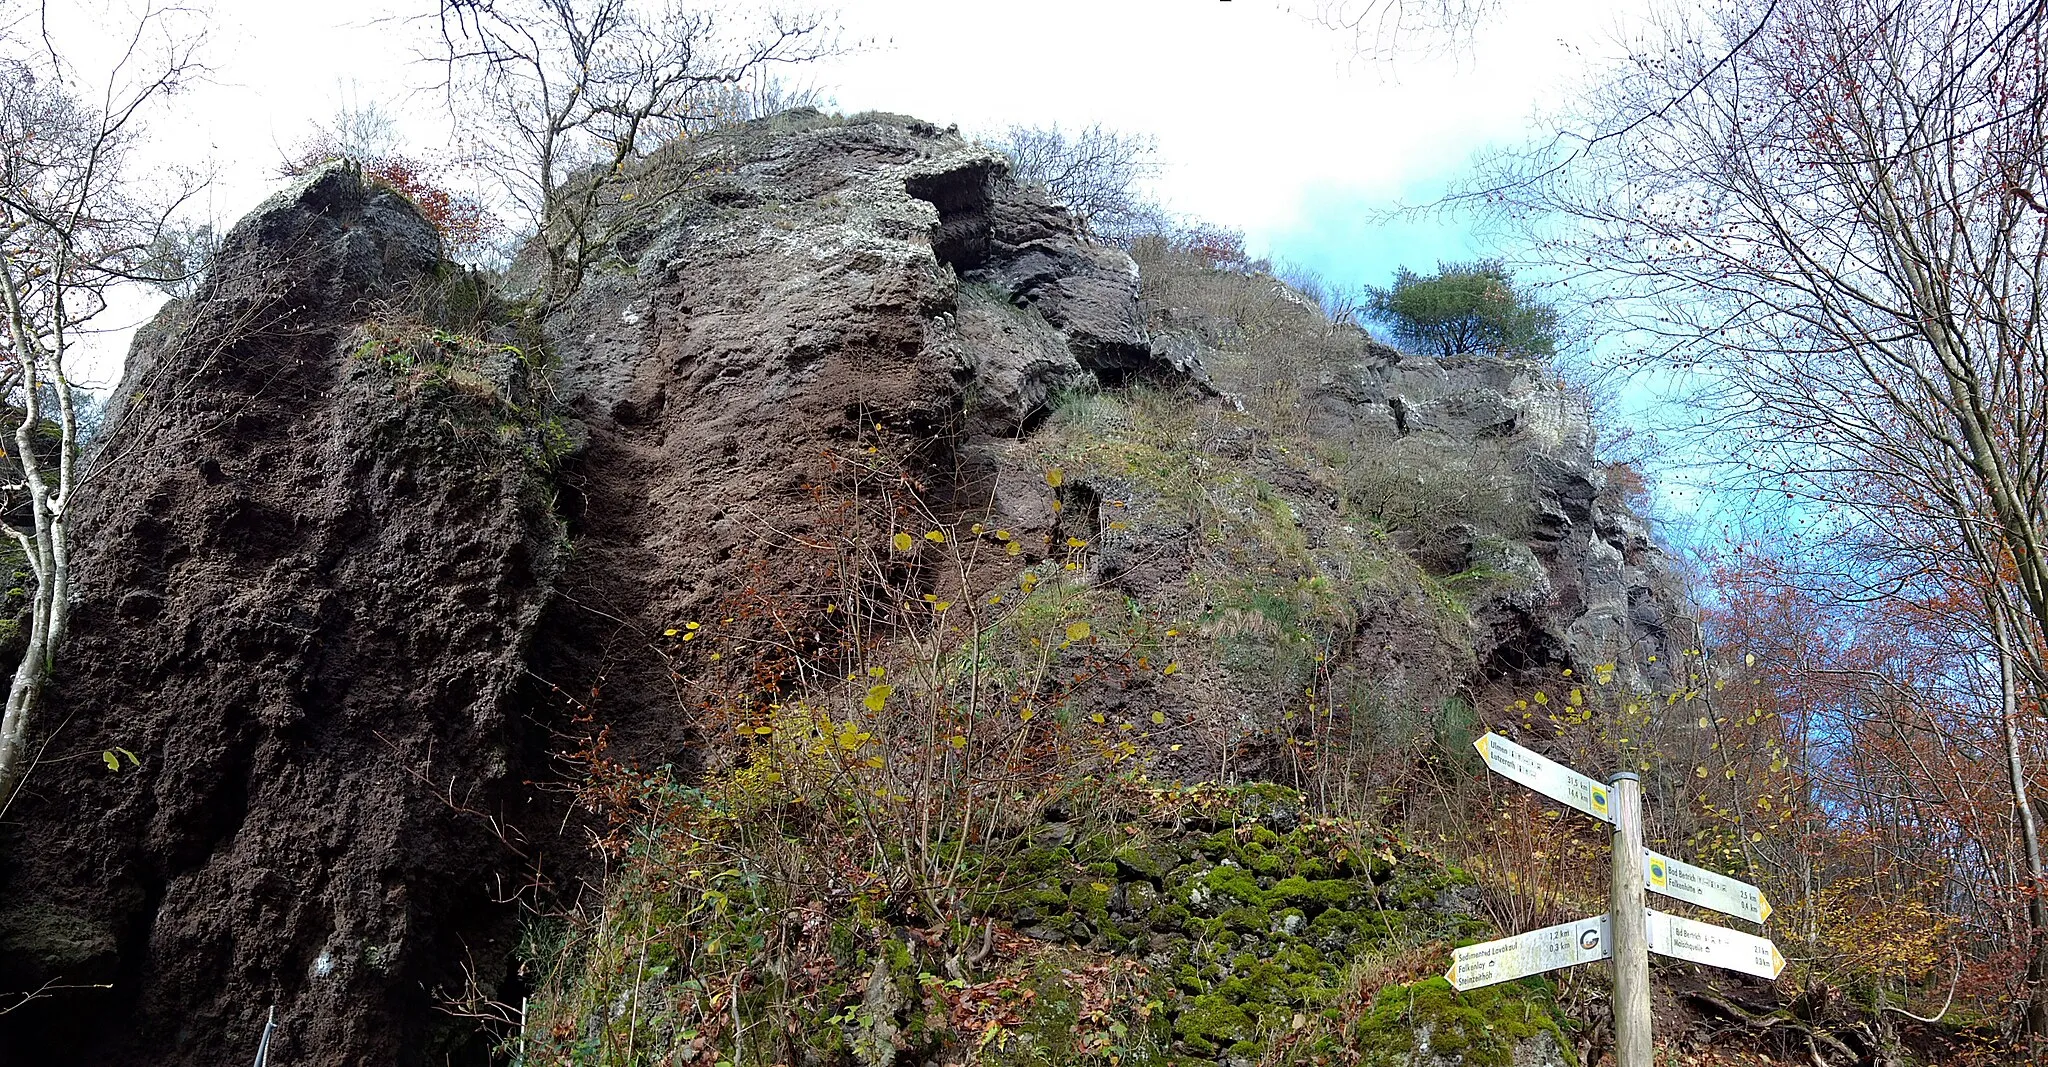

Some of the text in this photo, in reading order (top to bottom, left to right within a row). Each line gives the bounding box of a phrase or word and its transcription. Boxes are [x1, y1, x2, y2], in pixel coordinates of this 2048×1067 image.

[1490, 740, 1508, 755] Ulmen
[1668, 866, 1678, 877] Bad
[1678, 871, 1696, 882] Bertrich
[1750, 892, 1757, 902] km
[1750, 903, 1758, 913] km
[1550, 930, 1570, 941] 1,2 km
[1684, 929, 1701, 940] Bertrich
[1550, 942, 1570, 953] 0,3 km
[1762, 947, 1769, 956] km
[1458, 961, 1486, 974] Falkenlay
[1763, 958, 1770, 967] km
